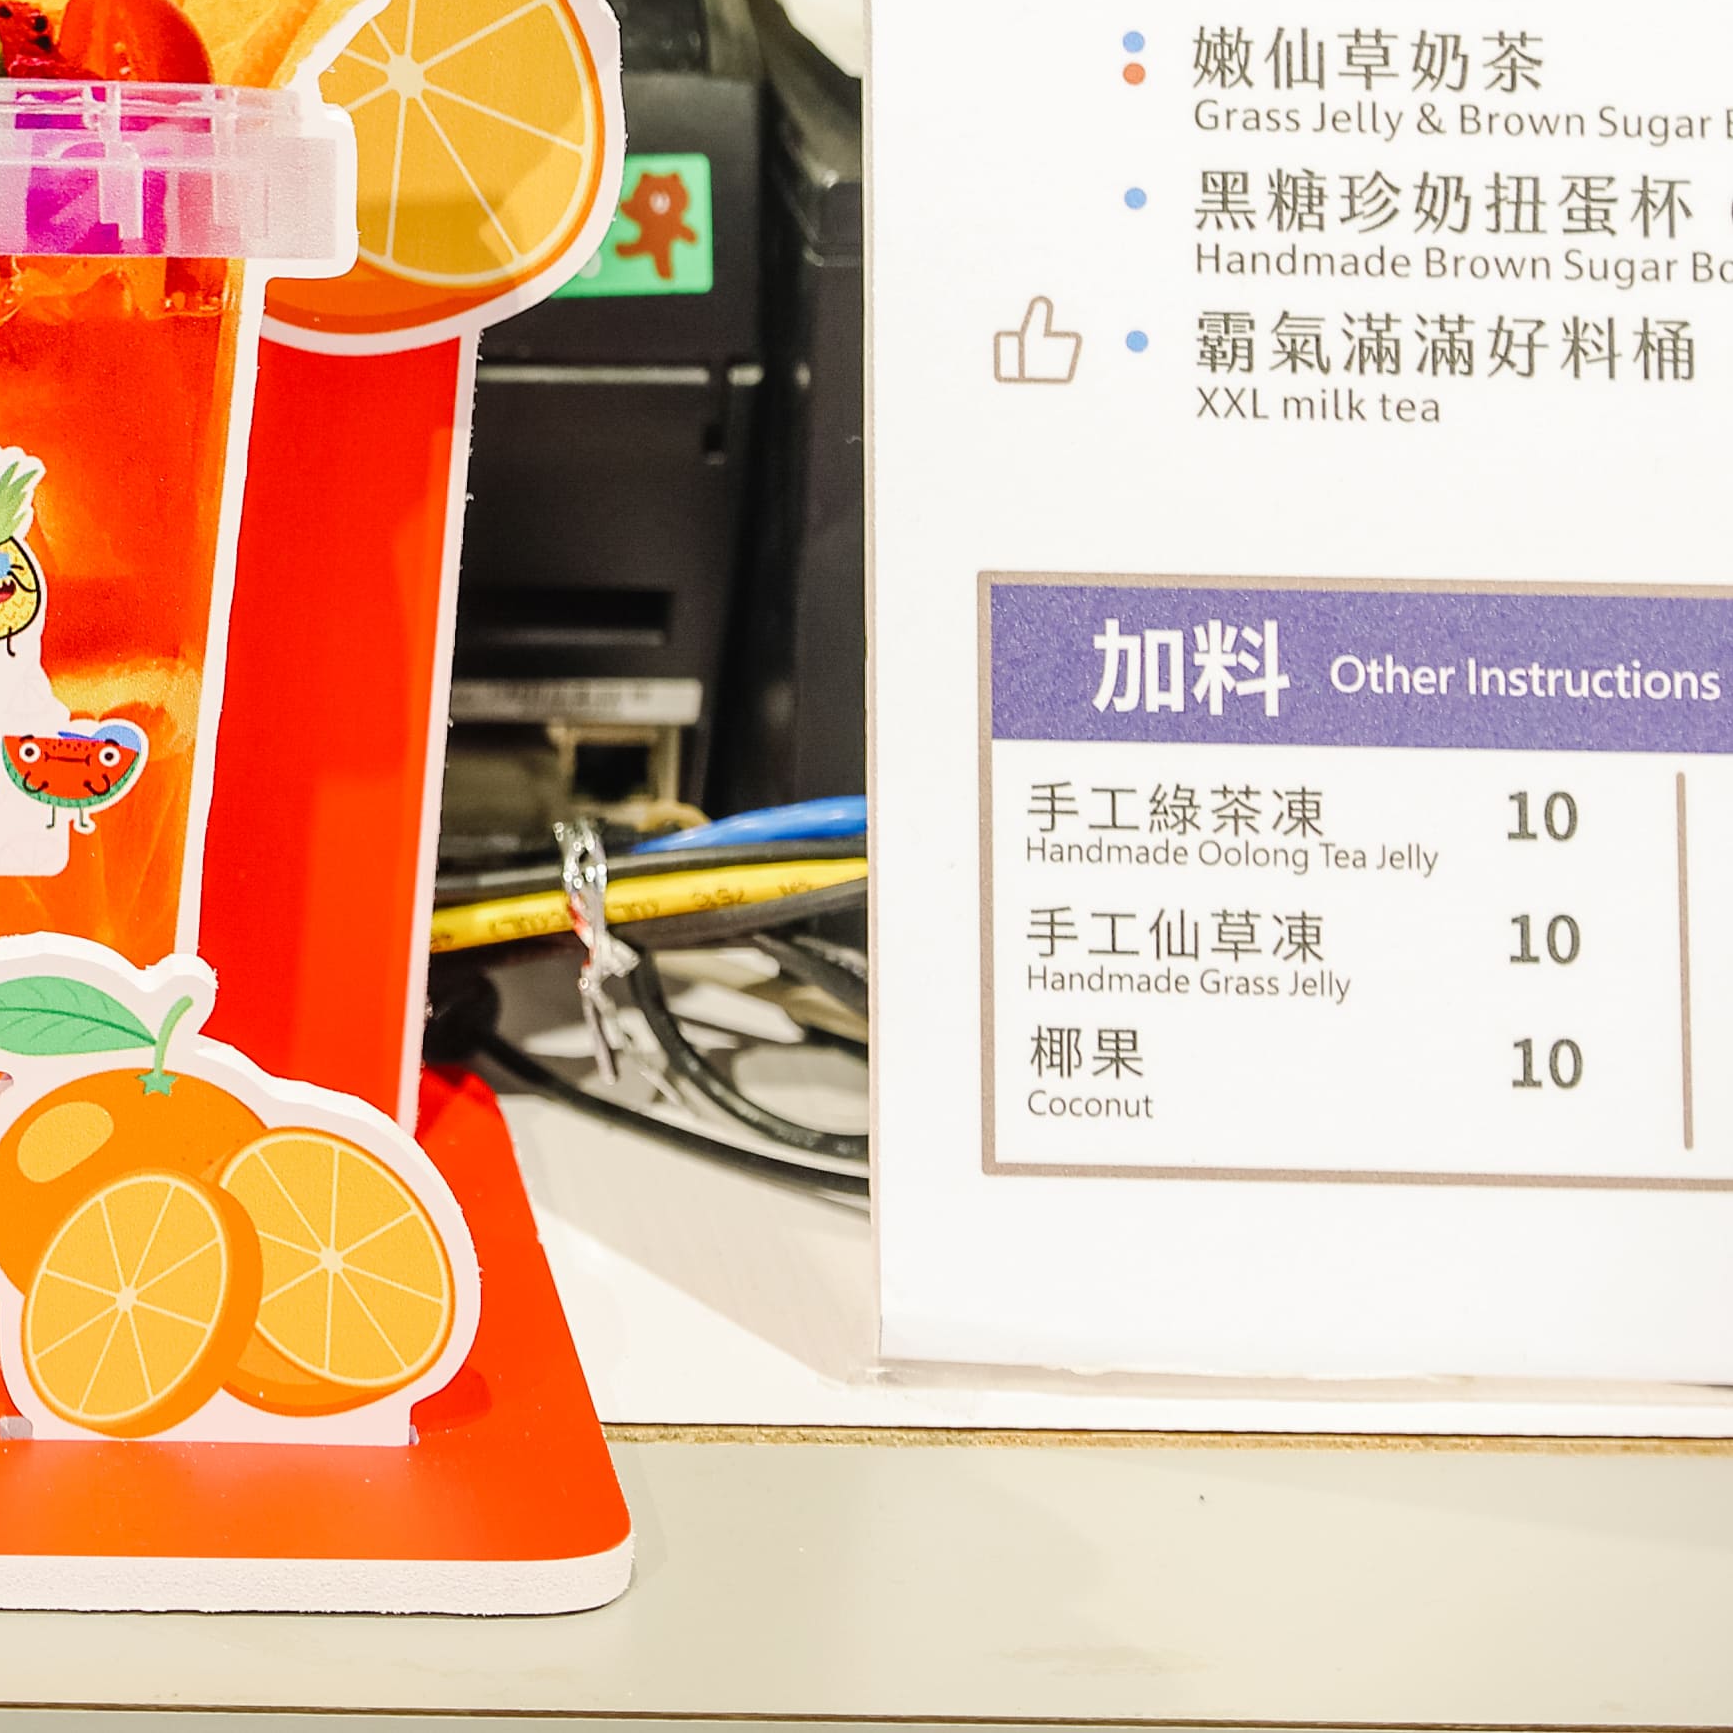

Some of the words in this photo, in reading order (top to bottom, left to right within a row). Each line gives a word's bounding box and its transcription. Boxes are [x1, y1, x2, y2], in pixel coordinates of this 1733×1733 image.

[1191, 24, 1544, 95] 嫩仙草奶茶
[1193, 97, 1302, 133] Grass
[1311, 99, 1405, 143] Jelly
[1415, 101, 1447, 136] &
[1458, 102, 1586, 138] Brown
[1597, 104, 1713, 148] Sugar
[1193, 166, 1694, 240] 黑糖珍奶扭蛋杯
[1195, 241, 1412, 279] Handmade
[1424, 245, 1552, 281] Brown
[1563, 247, 1679, 292] Sugar
[1195, 309, 1696, 382] 霸氣滿滿好料桶
[1196, 385, 1270, 420] XXL
[1282, 387, 1367, 422] milk
[1378, 392, 1441, 424] tea
[1086, 612, 1297, 723] 加料
[1327, 649, 1457, 699] Other
[1466, 656, 1724, 706] Instructions
[1026, 780, 1325, 838] 手工綠茶凍
[1506, 789, 1579, 843] 10
[1025, 835, 1190, 867] Handmade
[1197, 838, 1310, 877] Oolong
[1317, 841, 1368, 870] Tea
[1375, 842, 1440, 879] Jelly
[1025, 905, 1325, 965] 手工仙草凍
[1508, 912, 1582, 967] 10
[1026, 963, 1191, 995] Handmade
[1198, 967, 1281, 997] Grass
[1288, 968, 1352, 1006] Jelly
[1029, 1024, 1144, 1080] 椰果
[1510, 1036, 1585, 1091] 10
[1026, 1088, 1154, 1120] Coconut
